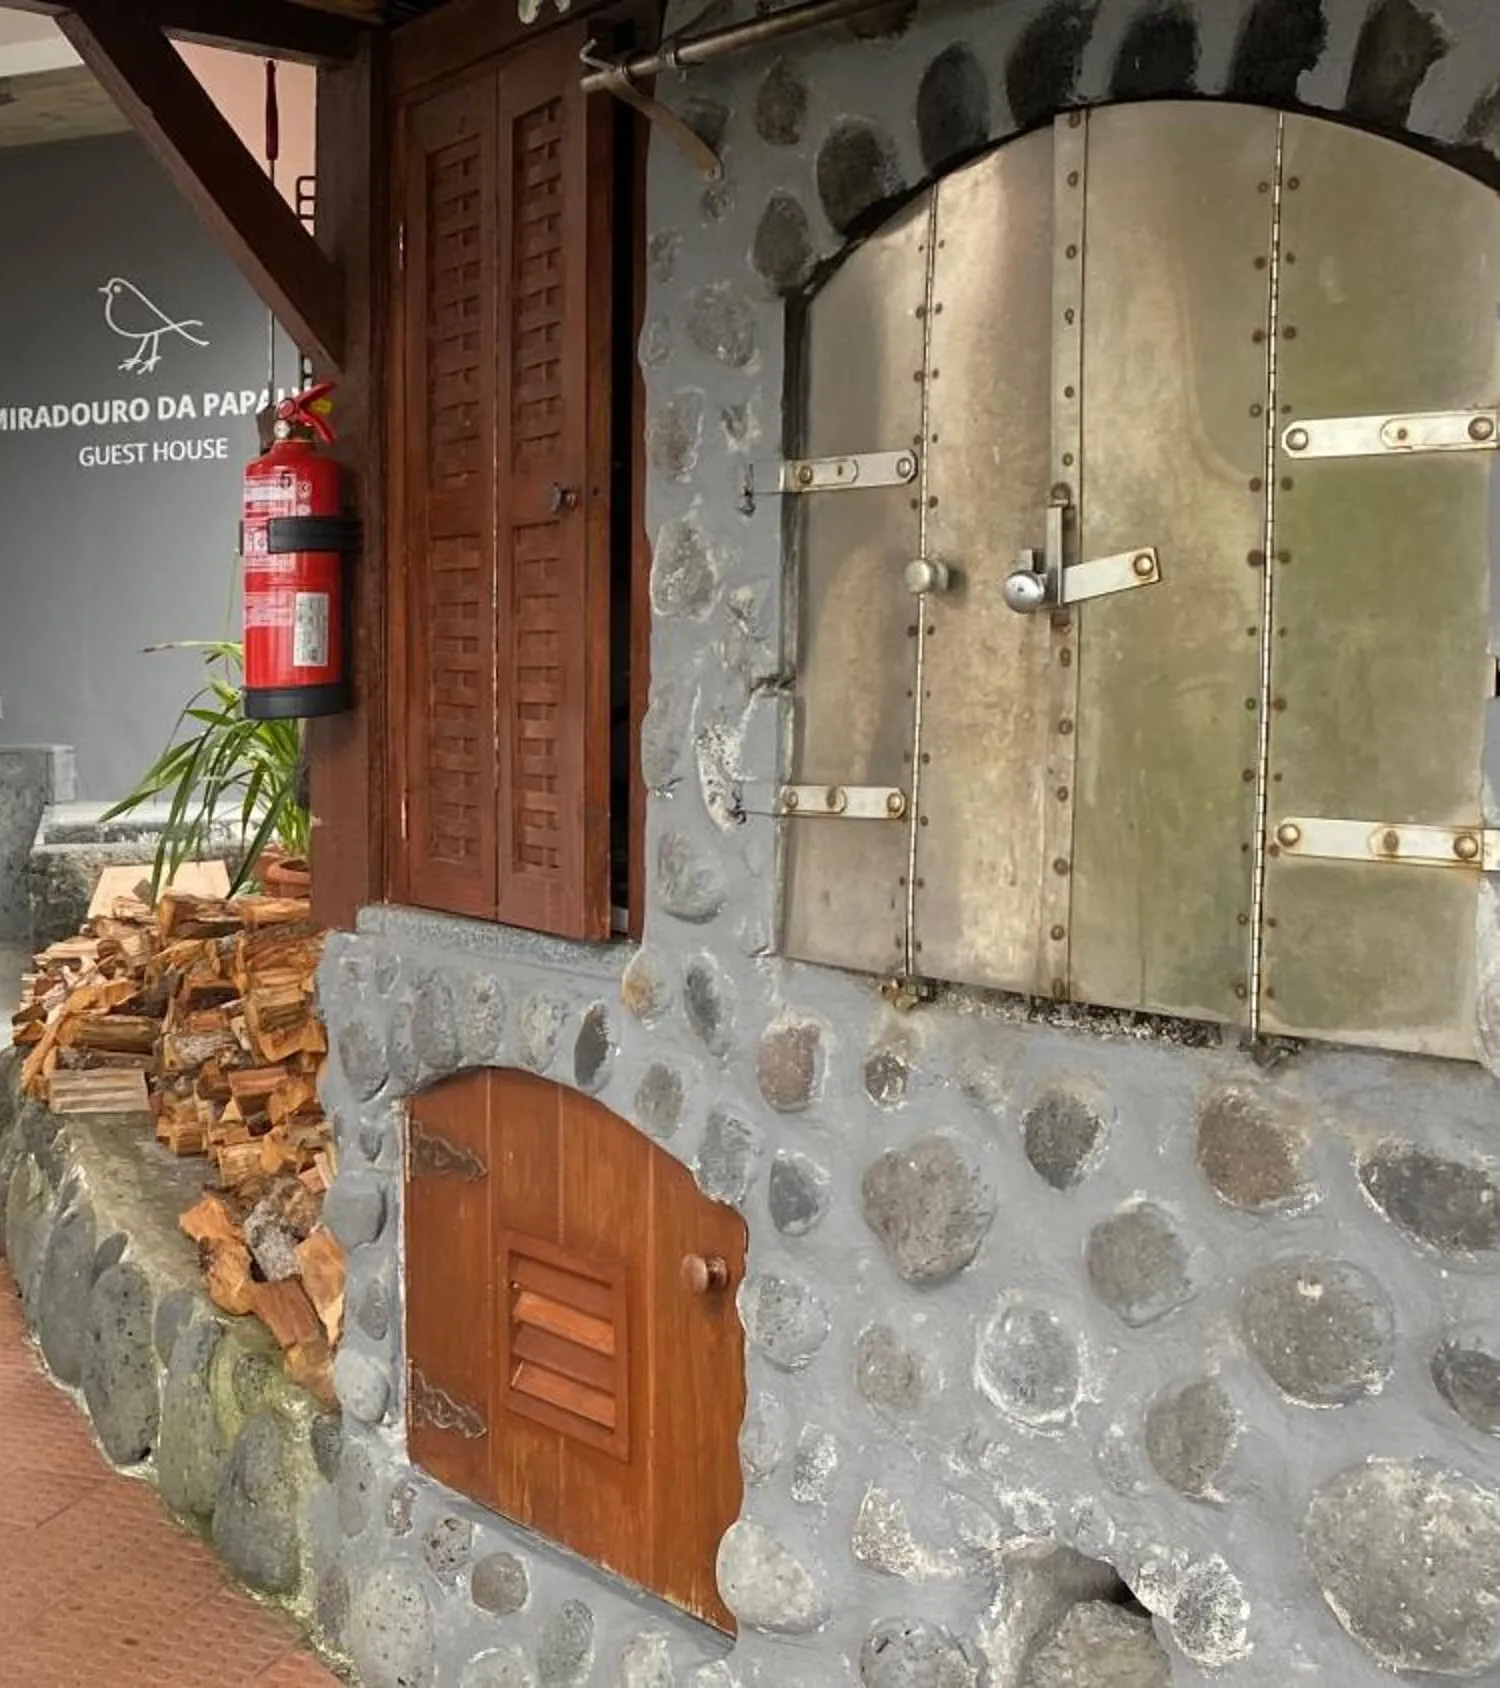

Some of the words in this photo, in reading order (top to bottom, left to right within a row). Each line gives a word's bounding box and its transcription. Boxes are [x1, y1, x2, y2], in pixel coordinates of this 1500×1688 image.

[157, 394, 197, 420] DA
[79, 443, 148, 467] GUEST
[153, 437, 229, 462] HOUSE
